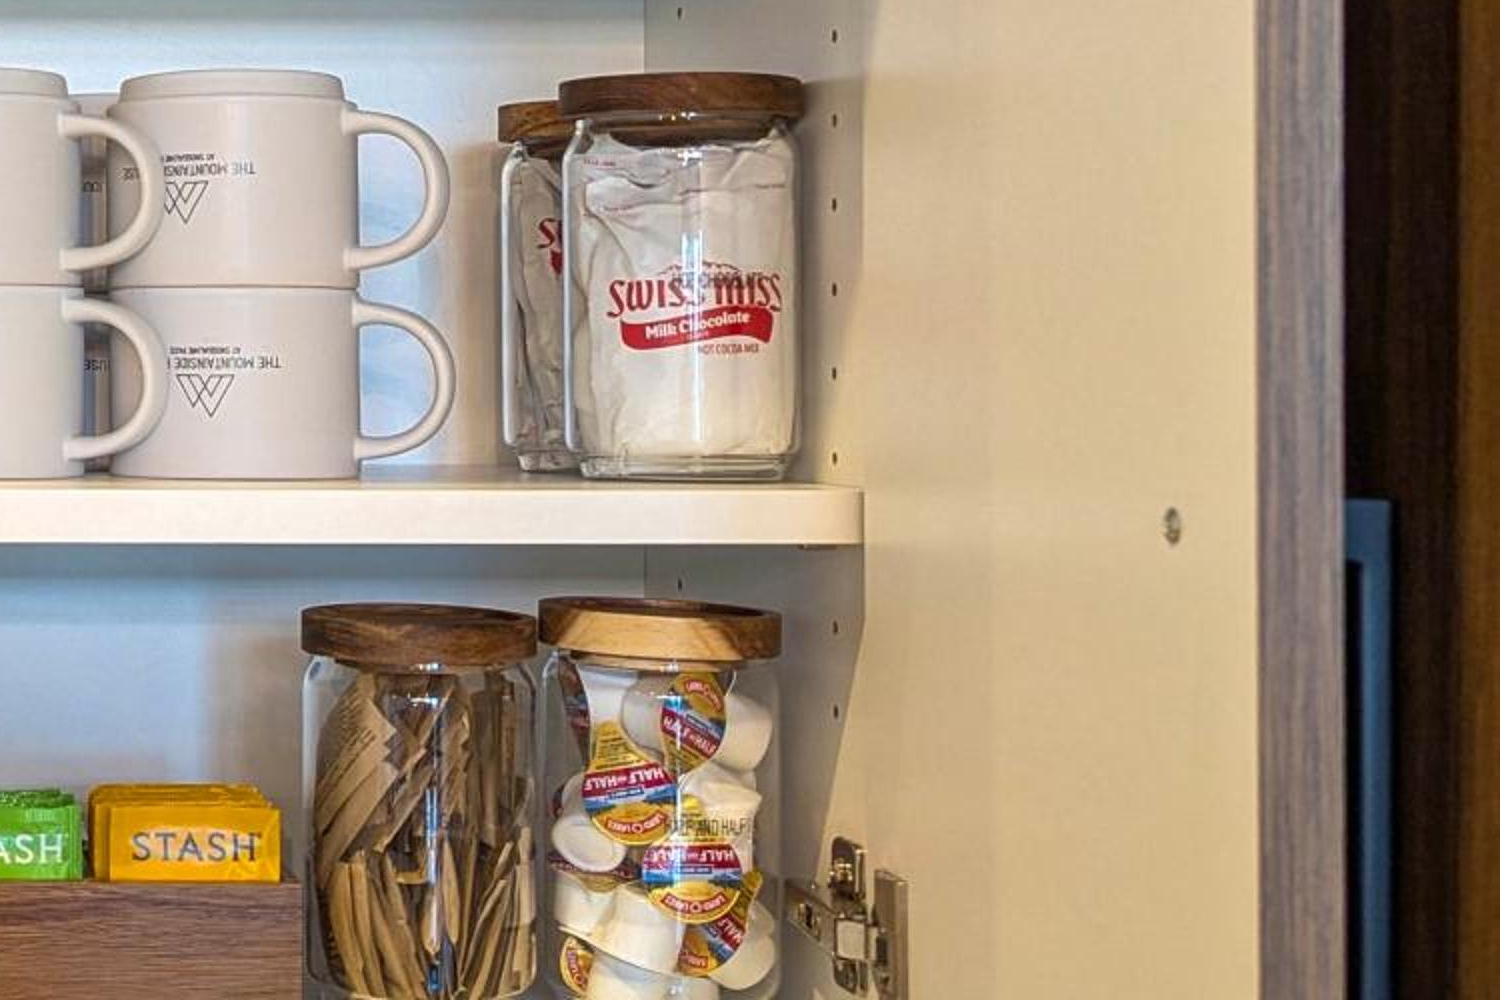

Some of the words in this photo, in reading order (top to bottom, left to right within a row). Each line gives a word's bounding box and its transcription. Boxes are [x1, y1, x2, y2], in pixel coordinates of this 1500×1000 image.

[644, 324, 678, 340] Milk
[678, 311, 751, 334] Chocolate
[583, 776, 618, 791] HALF
[628, 766, 665, 785] HALF
[131, 830, 257, 863] STASH
[700, 848, 735, 862] HALF
